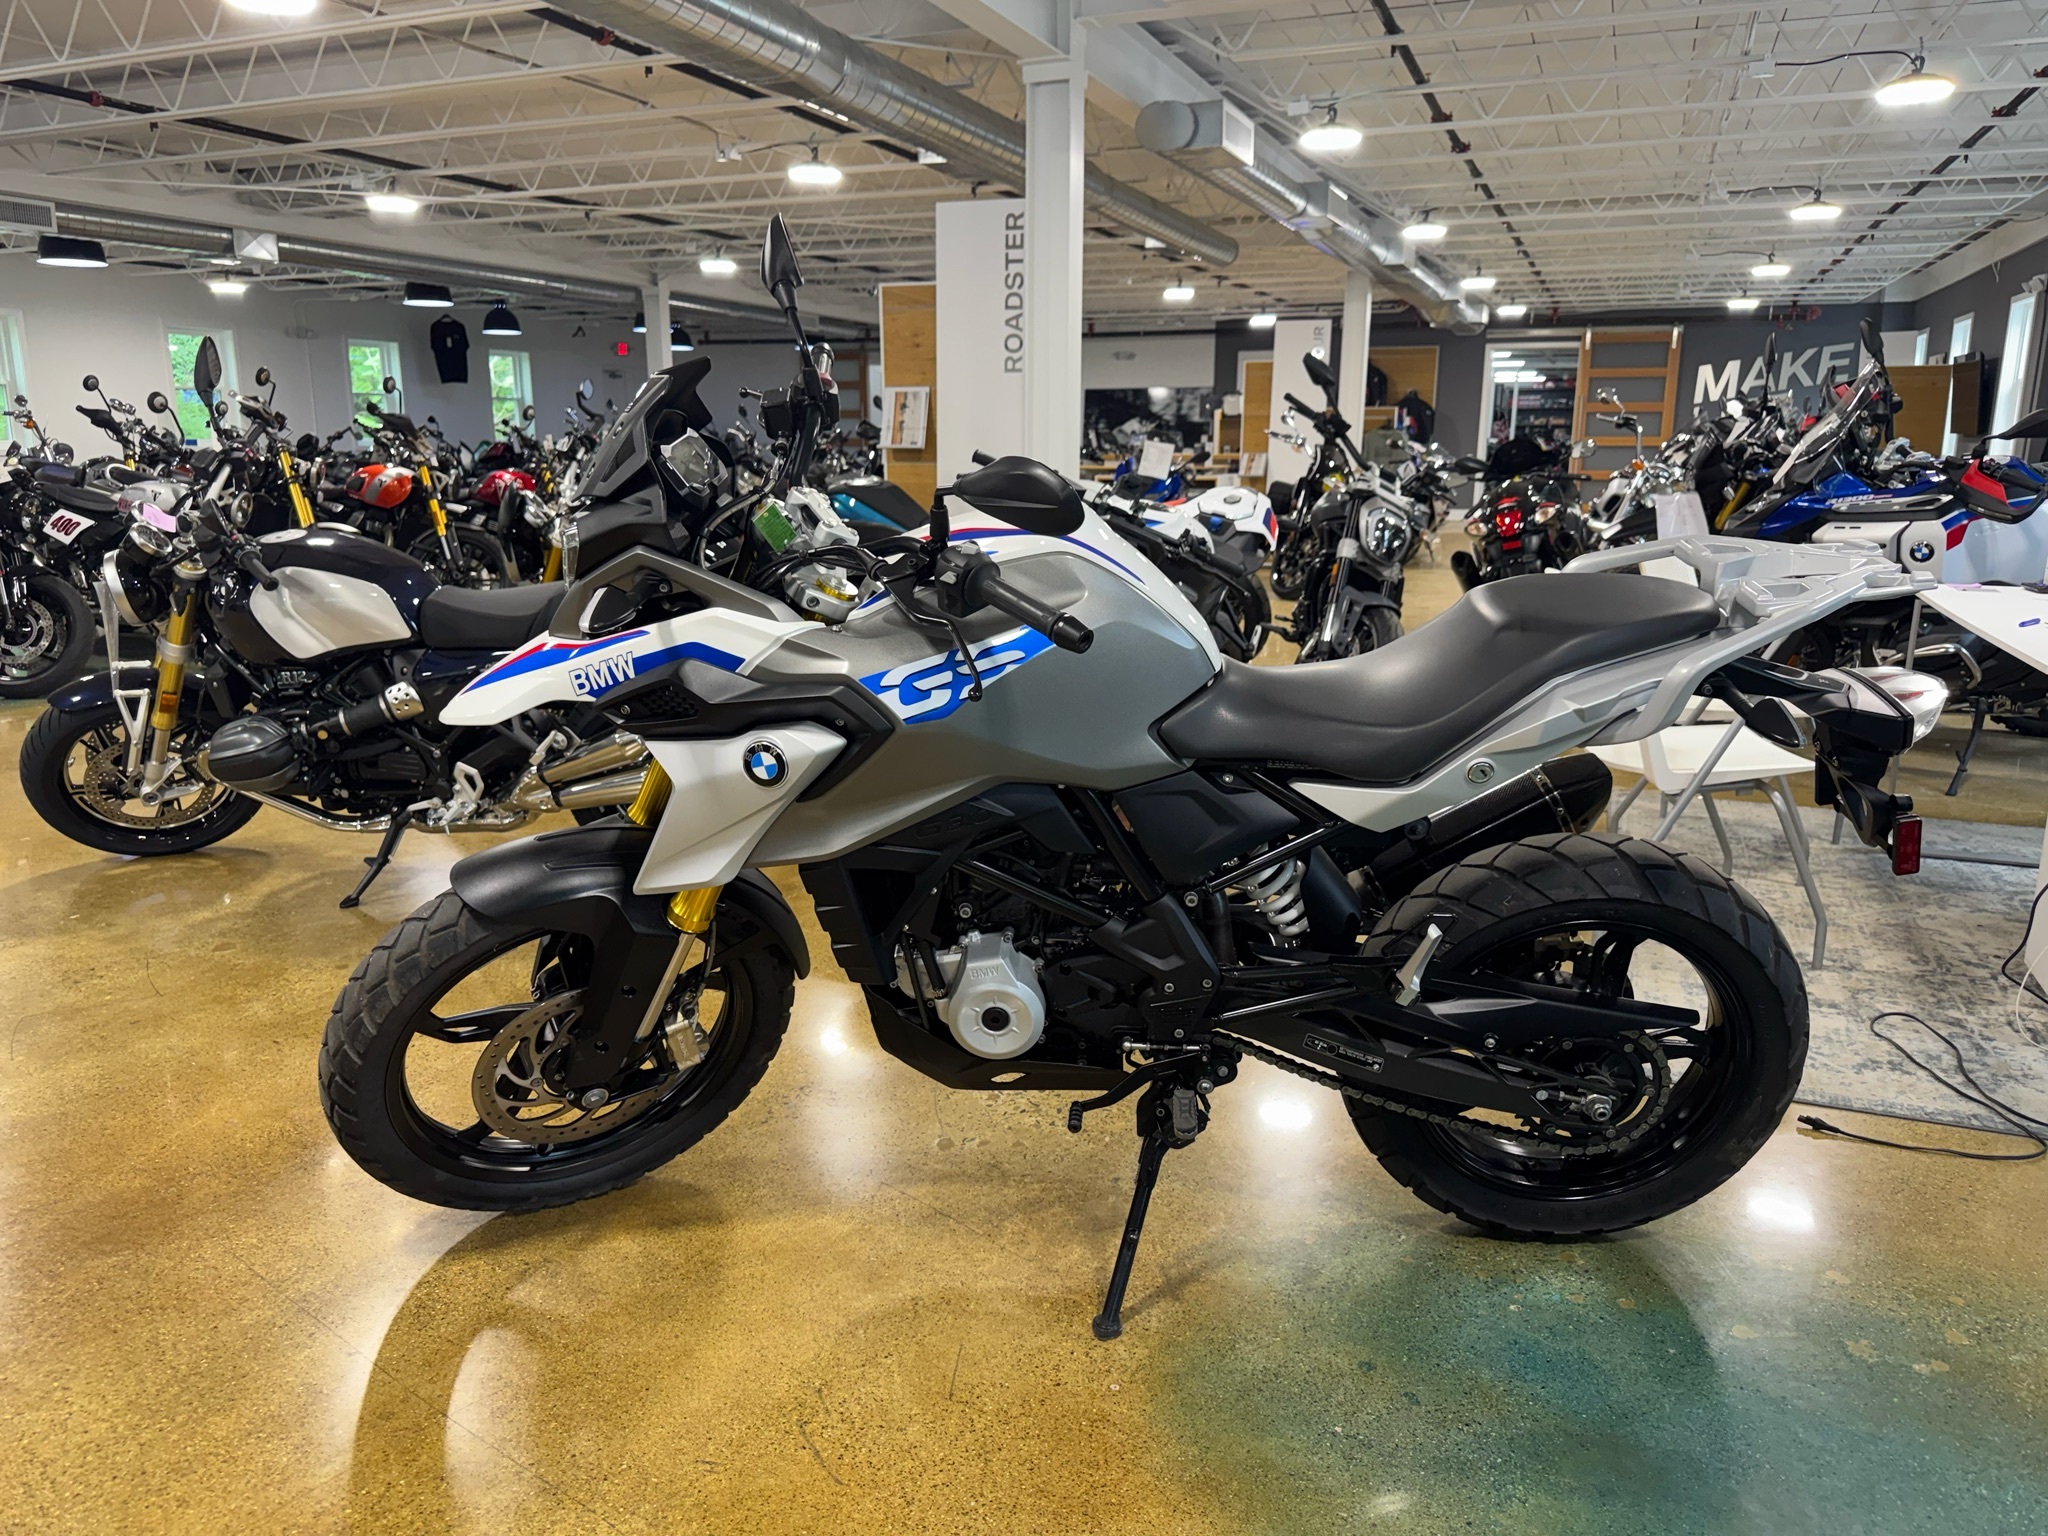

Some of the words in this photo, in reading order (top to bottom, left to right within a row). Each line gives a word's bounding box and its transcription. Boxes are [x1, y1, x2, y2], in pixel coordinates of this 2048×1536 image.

[1004, 211, 1025, 373] ROADSTER
[1694, 342, 1855, 404] MAKE
[50, 515, 81, 537] 400
[568, 651, 636, 697] BMW
[877, 628, 1031, 721] GS
[745, 743, 778, 762] BMW
[971, 966, 999, 979] BMW
